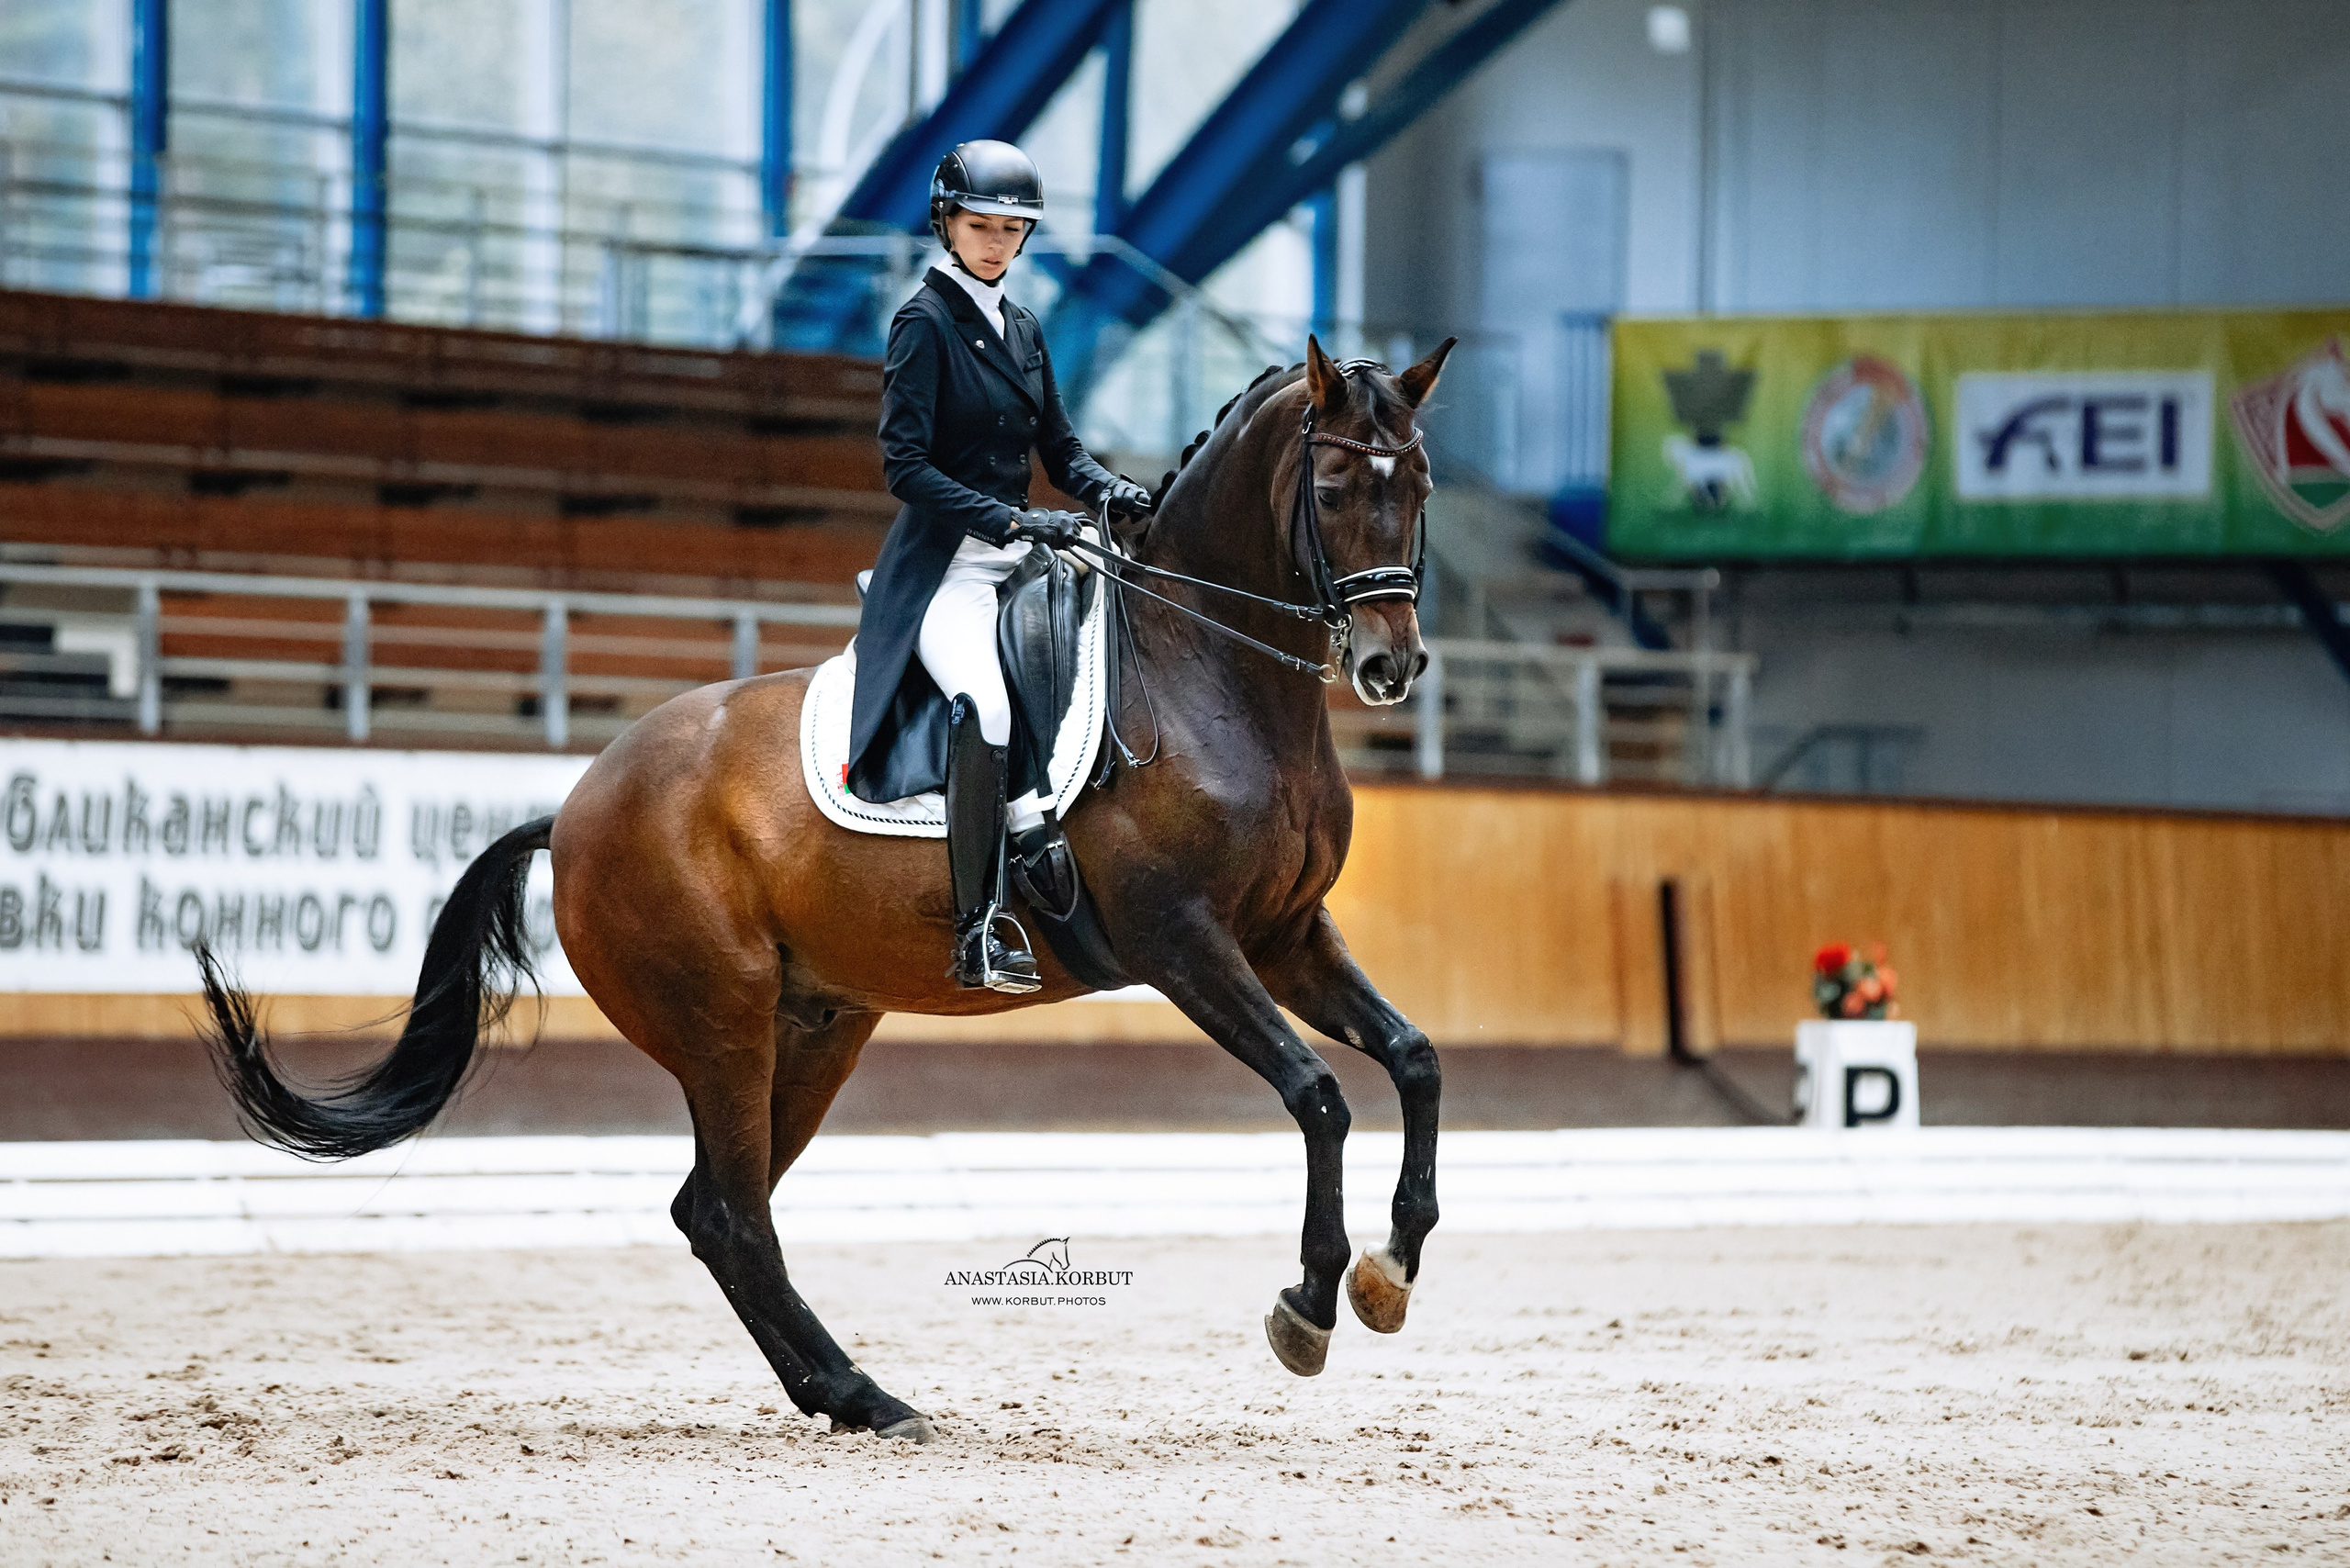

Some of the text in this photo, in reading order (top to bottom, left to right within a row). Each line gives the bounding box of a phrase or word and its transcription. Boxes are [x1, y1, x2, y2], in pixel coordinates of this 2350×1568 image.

[410, 799, 562, 871] цен
[136, 875, 397, 953] конного
[1844, 1065, 1900, 1127] P
